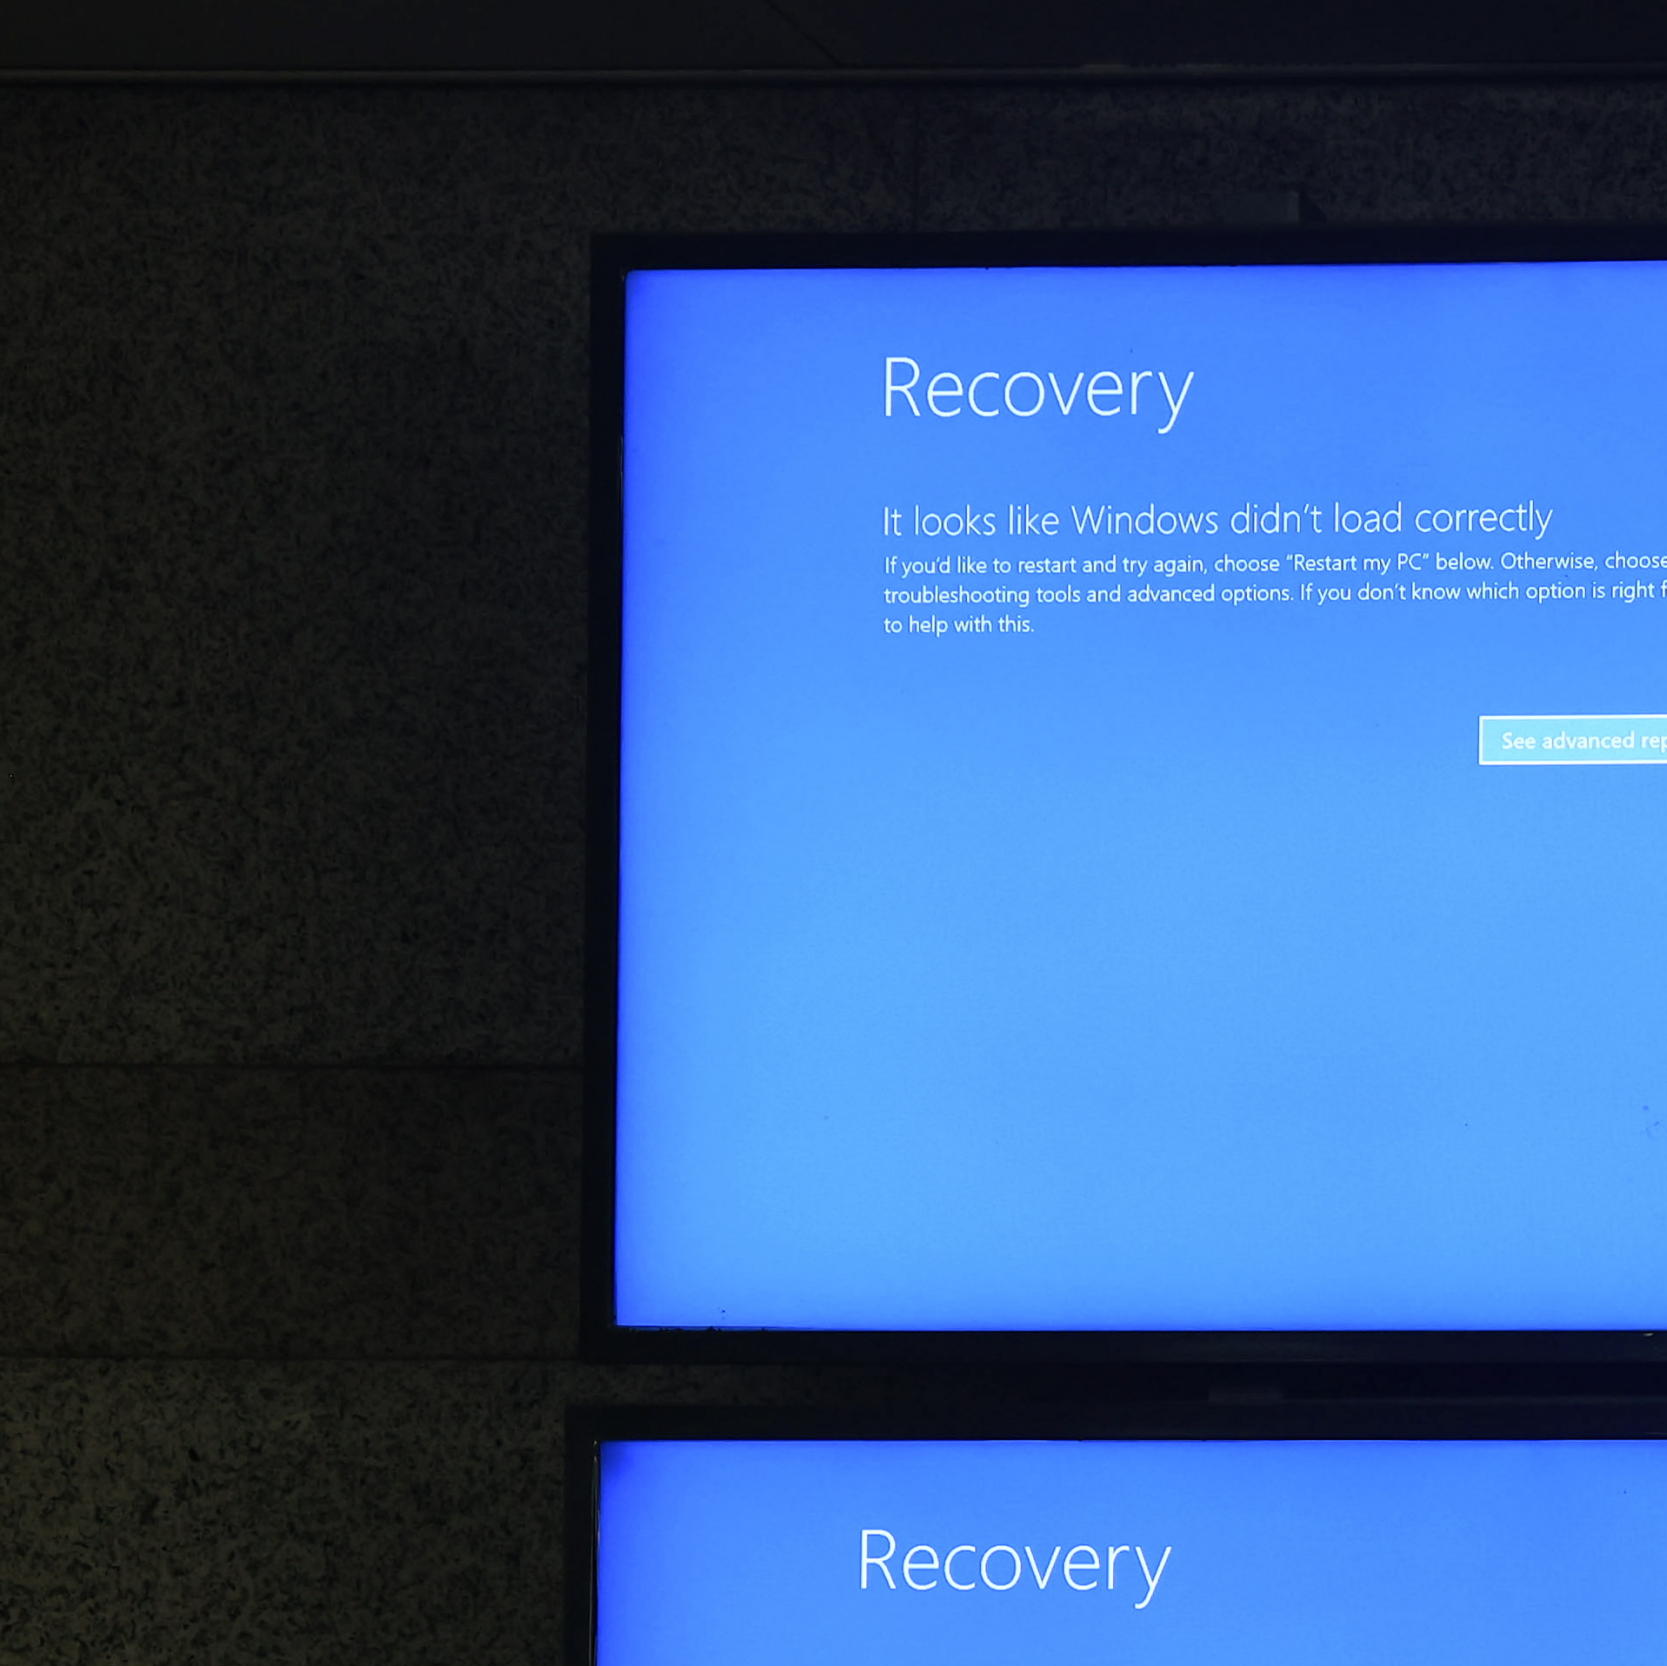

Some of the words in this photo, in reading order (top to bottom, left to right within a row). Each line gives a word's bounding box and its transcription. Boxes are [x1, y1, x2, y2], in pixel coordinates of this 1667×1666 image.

[885, 356, 1195, 435] Recovery
[883, 506, 903, 537] It
[914, 503, 997, 537] looks
[1009, 503, 1060, 536] like
[1071, 503, 1219, 535] Windows
[1334, 500, 1402, 534] load
[1414, 499, 1554, 541] correctly
[883, 617, 903, 634] to
[909, 614, 949, 638] help
[953, 614, 993, 633] with
[997, 614, 1035, 633] this.
[860, 1528, 1173, 1610] Recovery
